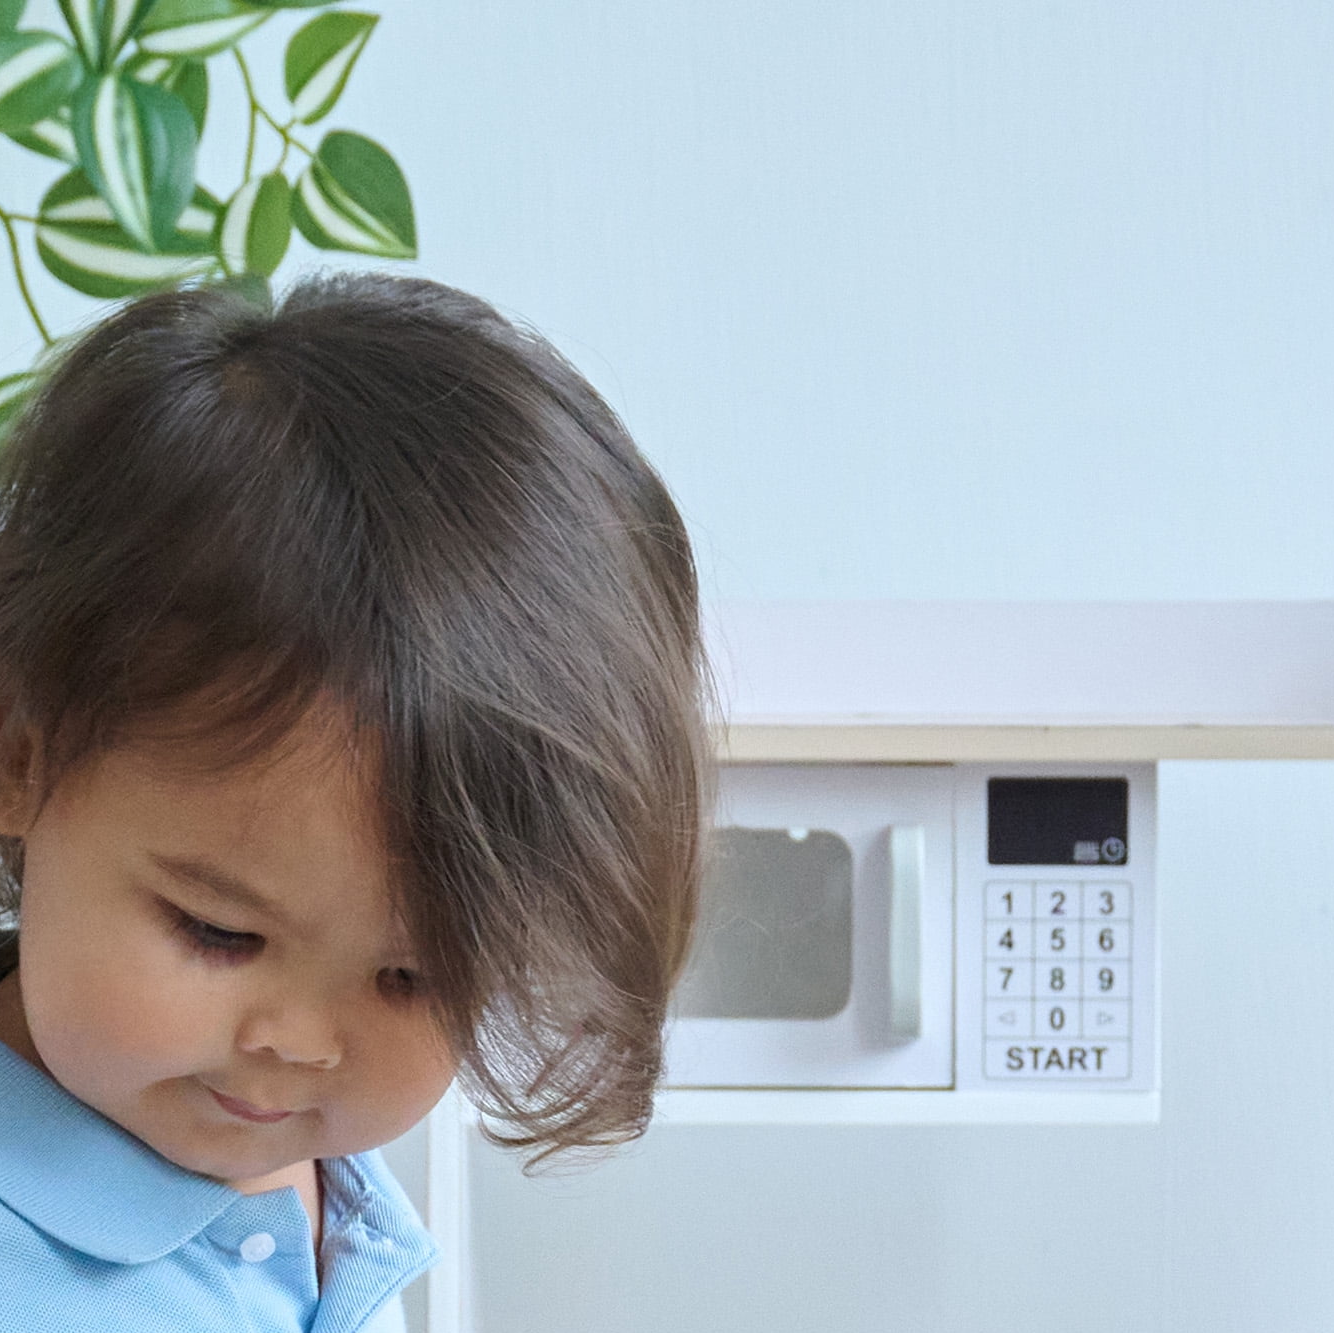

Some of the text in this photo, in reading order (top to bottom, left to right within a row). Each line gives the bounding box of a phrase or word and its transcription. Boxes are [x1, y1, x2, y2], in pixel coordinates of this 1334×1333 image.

[1001, 890, 1115, 916] 1 2 3
[998, 928, 1115, 952] 4 5 6
[999, 967, 1114, 991] 7 8 9
[1049, 1006, 1066, 1031] 0
[1006, 1046, 1108, 1071] START
